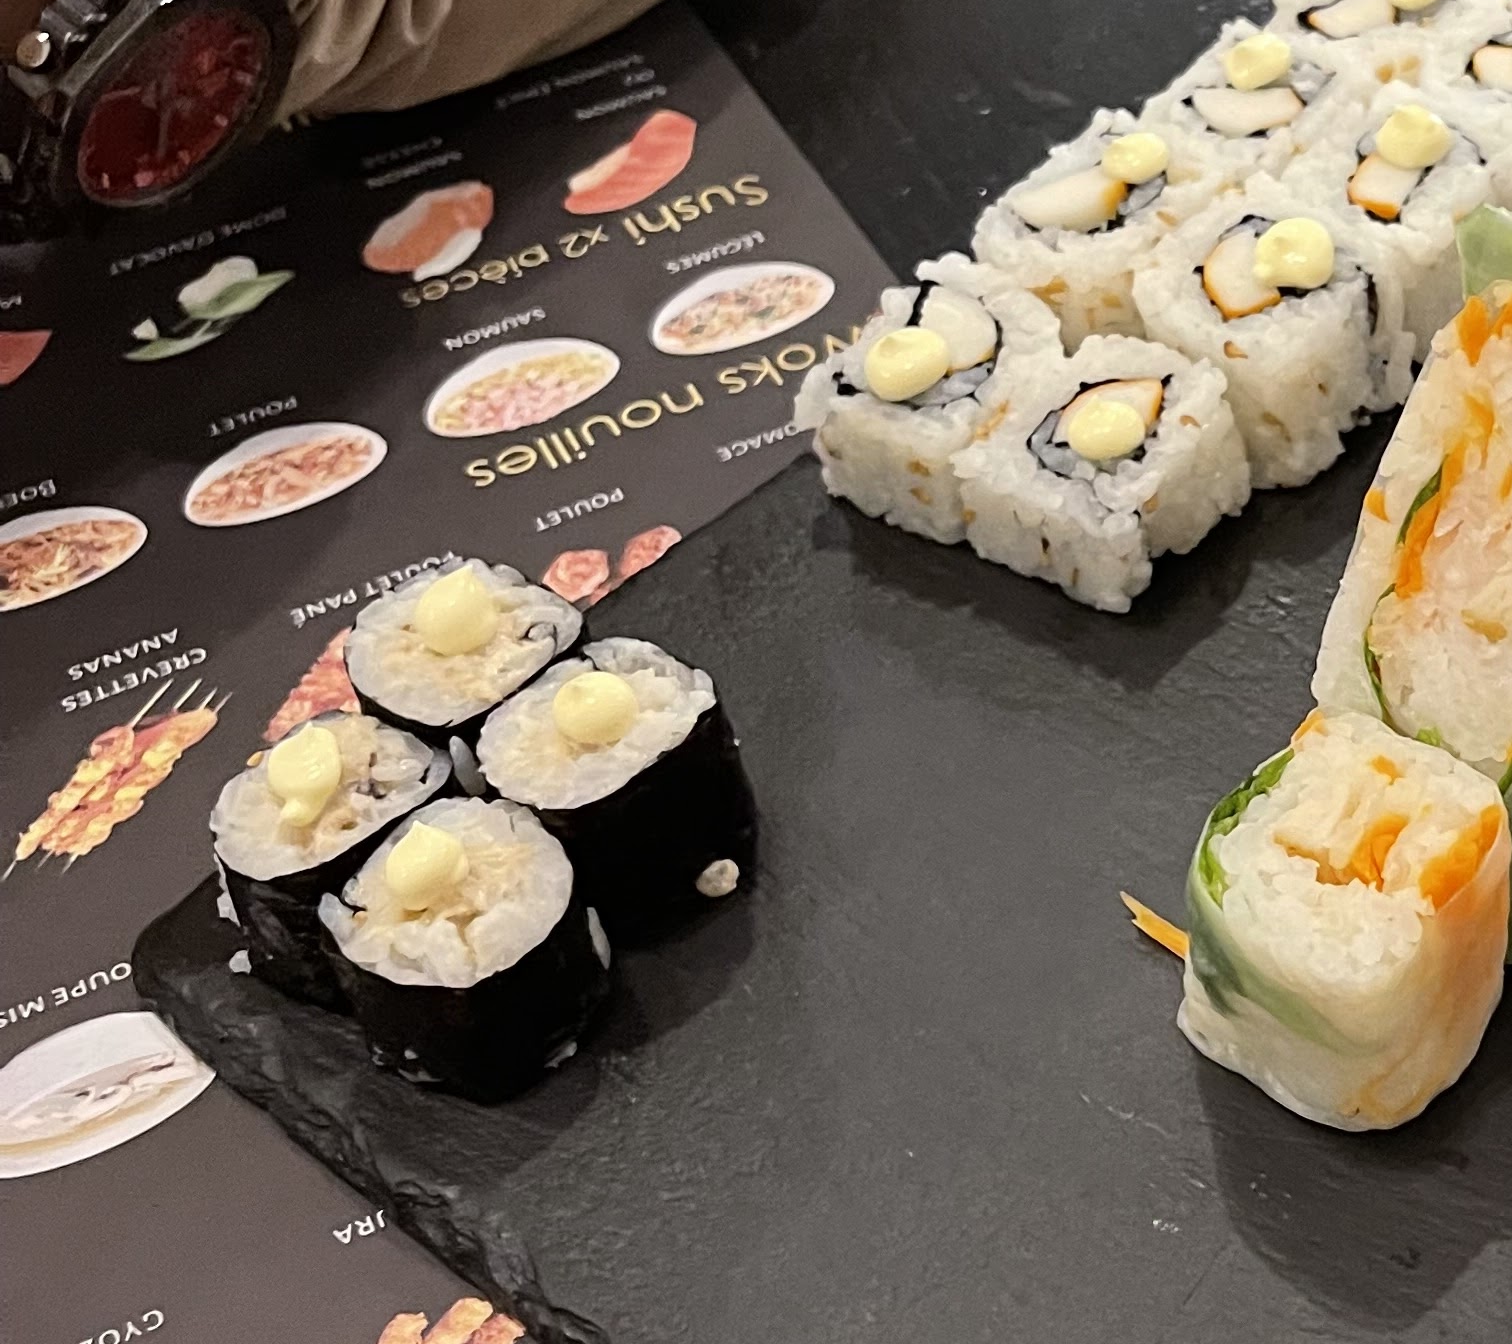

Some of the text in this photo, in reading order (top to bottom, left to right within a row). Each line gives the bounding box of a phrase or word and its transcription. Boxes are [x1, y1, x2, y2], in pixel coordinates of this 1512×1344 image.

[400, 173, 769, 308] Sushi x2 pièces
[665, 230, 765, 274] LÉGUMES
[445, 307, 546, 351] SAUMON
[208, 395, 298, 438] POULET
[466, 381, 704, 487] nouilles
[534, 487, 625, 532] POULET
[289, 587, 358, 629] PANÉ
[67, 628, 179, 682] ANANAS
[61, 647, 207, 713] CREVETTES
[50, 961, 133, 1007] OUPE
